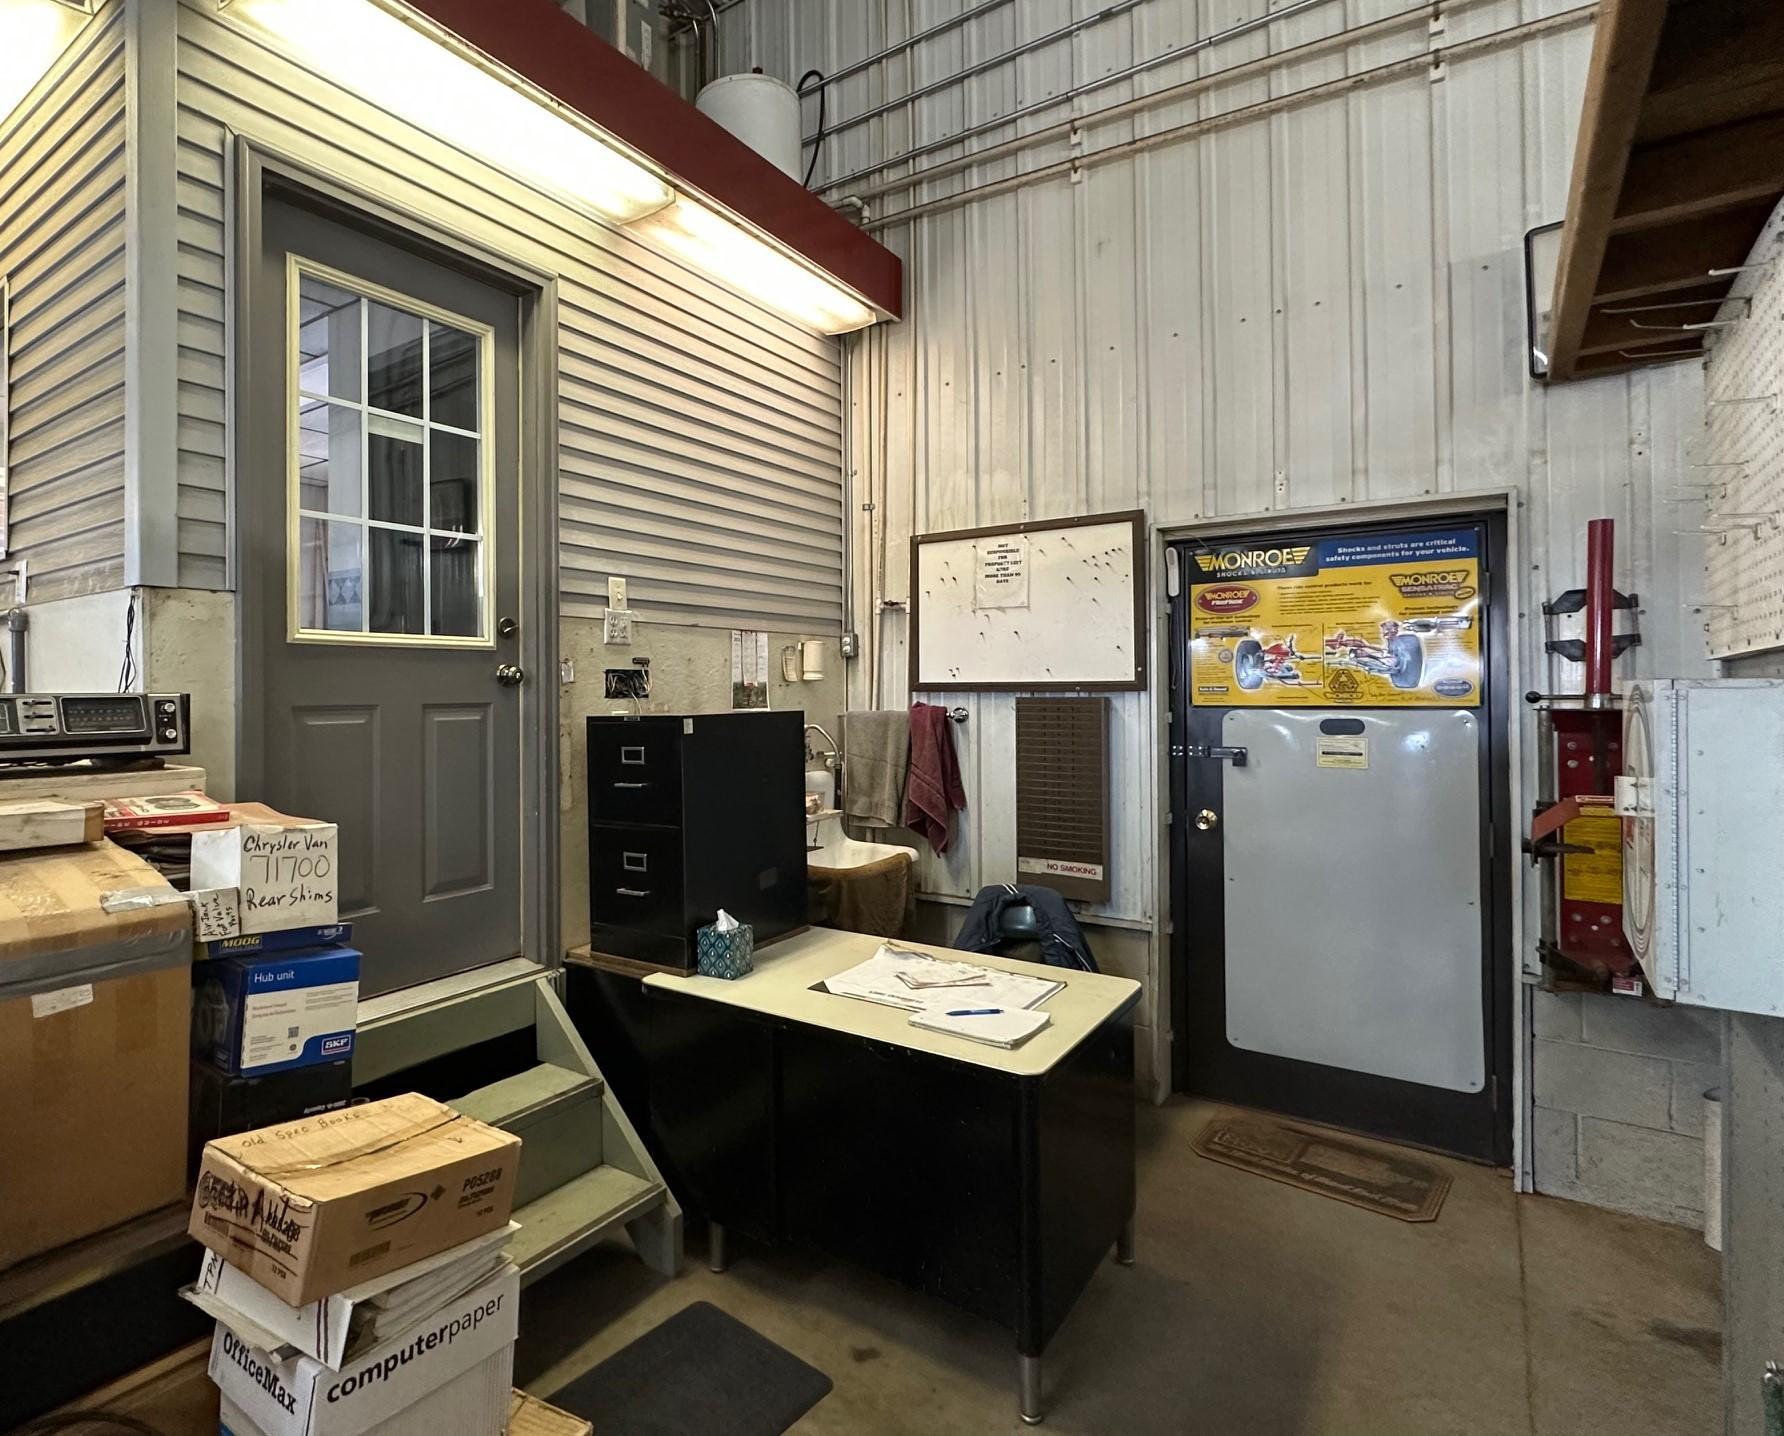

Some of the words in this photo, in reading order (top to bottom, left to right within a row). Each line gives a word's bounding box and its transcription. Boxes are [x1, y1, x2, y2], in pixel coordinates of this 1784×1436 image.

[1325, 554, 1350, 563] safety
[1351, 551, 1400, 561] components
[1401, 549, 1414, 557] for
[1415, 548, 1434, 557] your
[1436, 545, 1470, 555] vehicle.
[1337, 546, 1365, 554] Shocks
[1425, 538, 1456, 547] critical
[1208, 548, 1294, 571] MONROE
[1401, 572, 1457, 587] MONROE
[1211, 590, 1246, 600] MONROE
[243, 833, 300, 854] Chrysler
[304, 833, 328, 850] Van
[250, 854, 331, 884] 71700
[1047, 863, 1059, 871] NO
[1060, 864, 1097, 876] SMOKING
[246, 887, 286, 911] Rear
[288, 883, 333, 906] Shims
[221, 936, 260, 948] MOOG
[254, 972, 274, 983] Hub
[276, 970, 295, 980] unit
[324, 1038, 349, 1049] SKF
[242, 1135, 265, 1148] Old
[275, 1126, 310, 1140] Spec
[327, 1293, 505, 1404] computerpaper
[223, 1331, 296, 1416] OfficeMax
